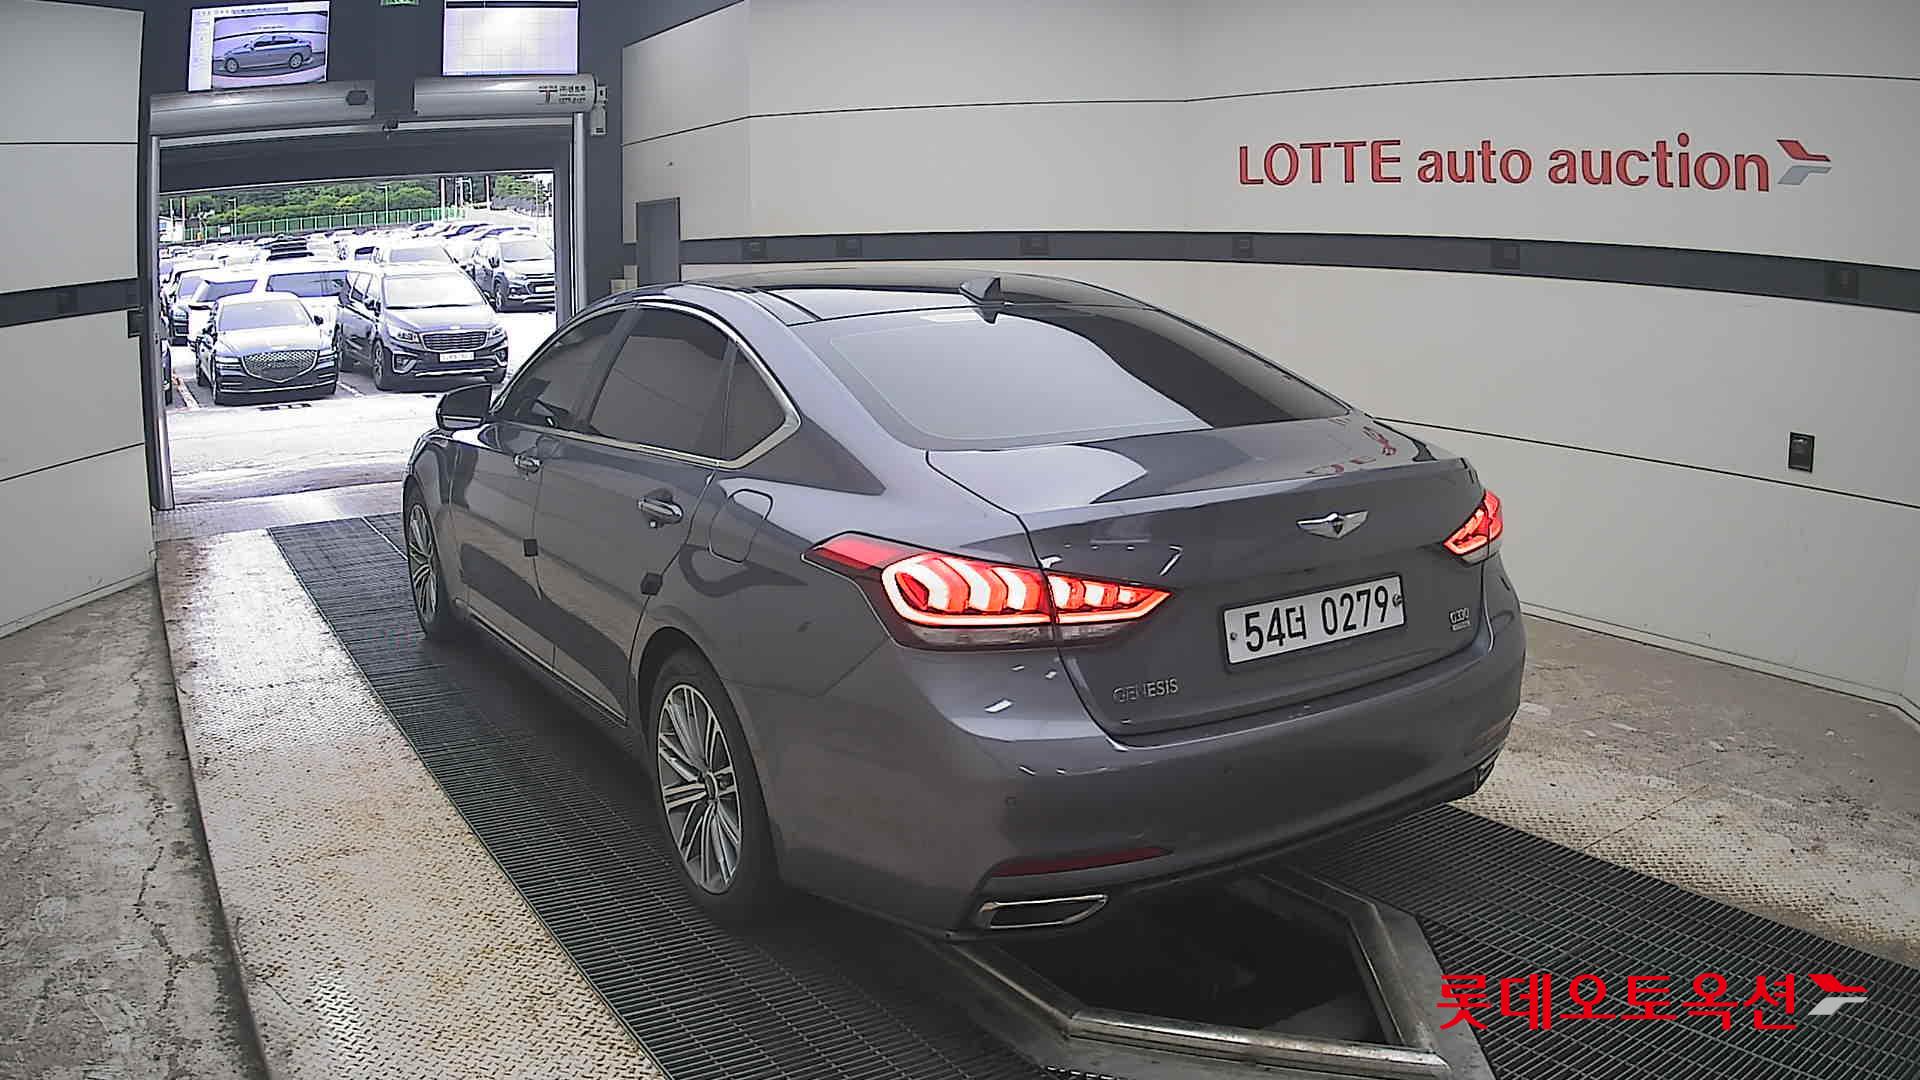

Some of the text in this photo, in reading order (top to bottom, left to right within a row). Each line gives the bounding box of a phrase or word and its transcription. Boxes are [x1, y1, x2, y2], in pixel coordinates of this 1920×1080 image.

[1239, 132, 1769, 192] LOTTE auto auction
[1245, 585, 1388, 652] 54더 0279
